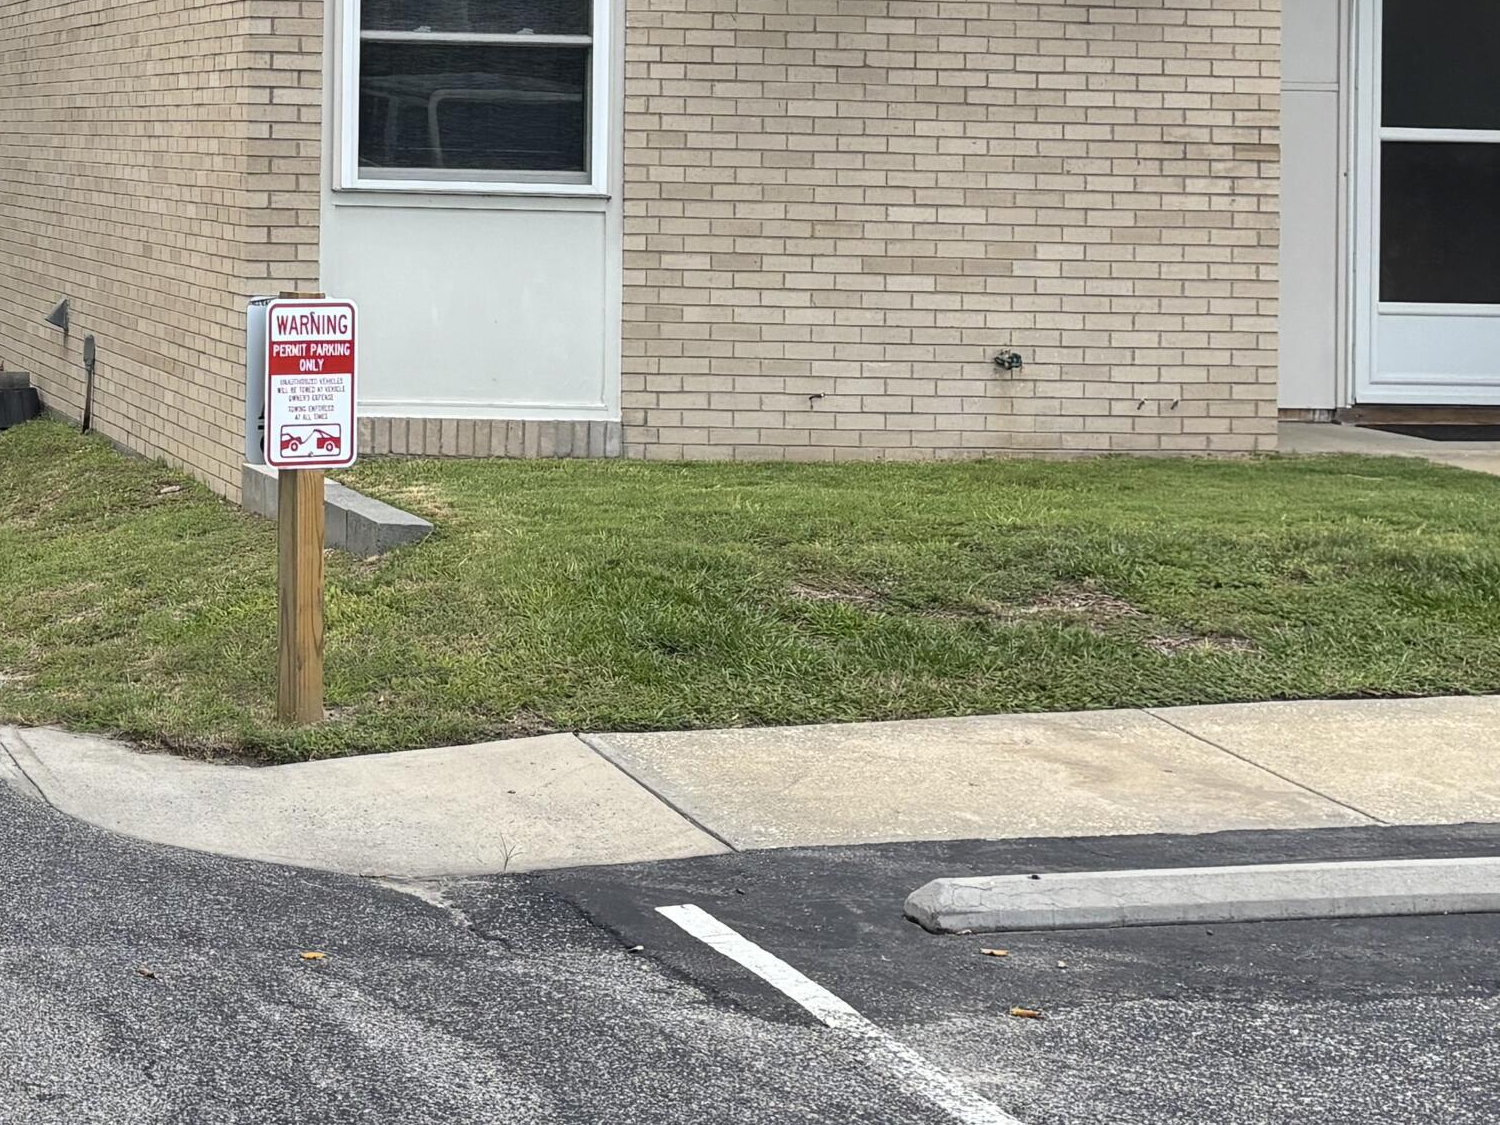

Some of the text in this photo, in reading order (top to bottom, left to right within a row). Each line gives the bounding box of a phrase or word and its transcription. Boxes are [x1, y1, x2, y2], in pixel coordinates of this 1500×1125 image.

[276, 314, 348, 335] WARNING
[273, 343, 350, 357] PERMIT PARKING
[299, 358, 325, 371] ONLY
